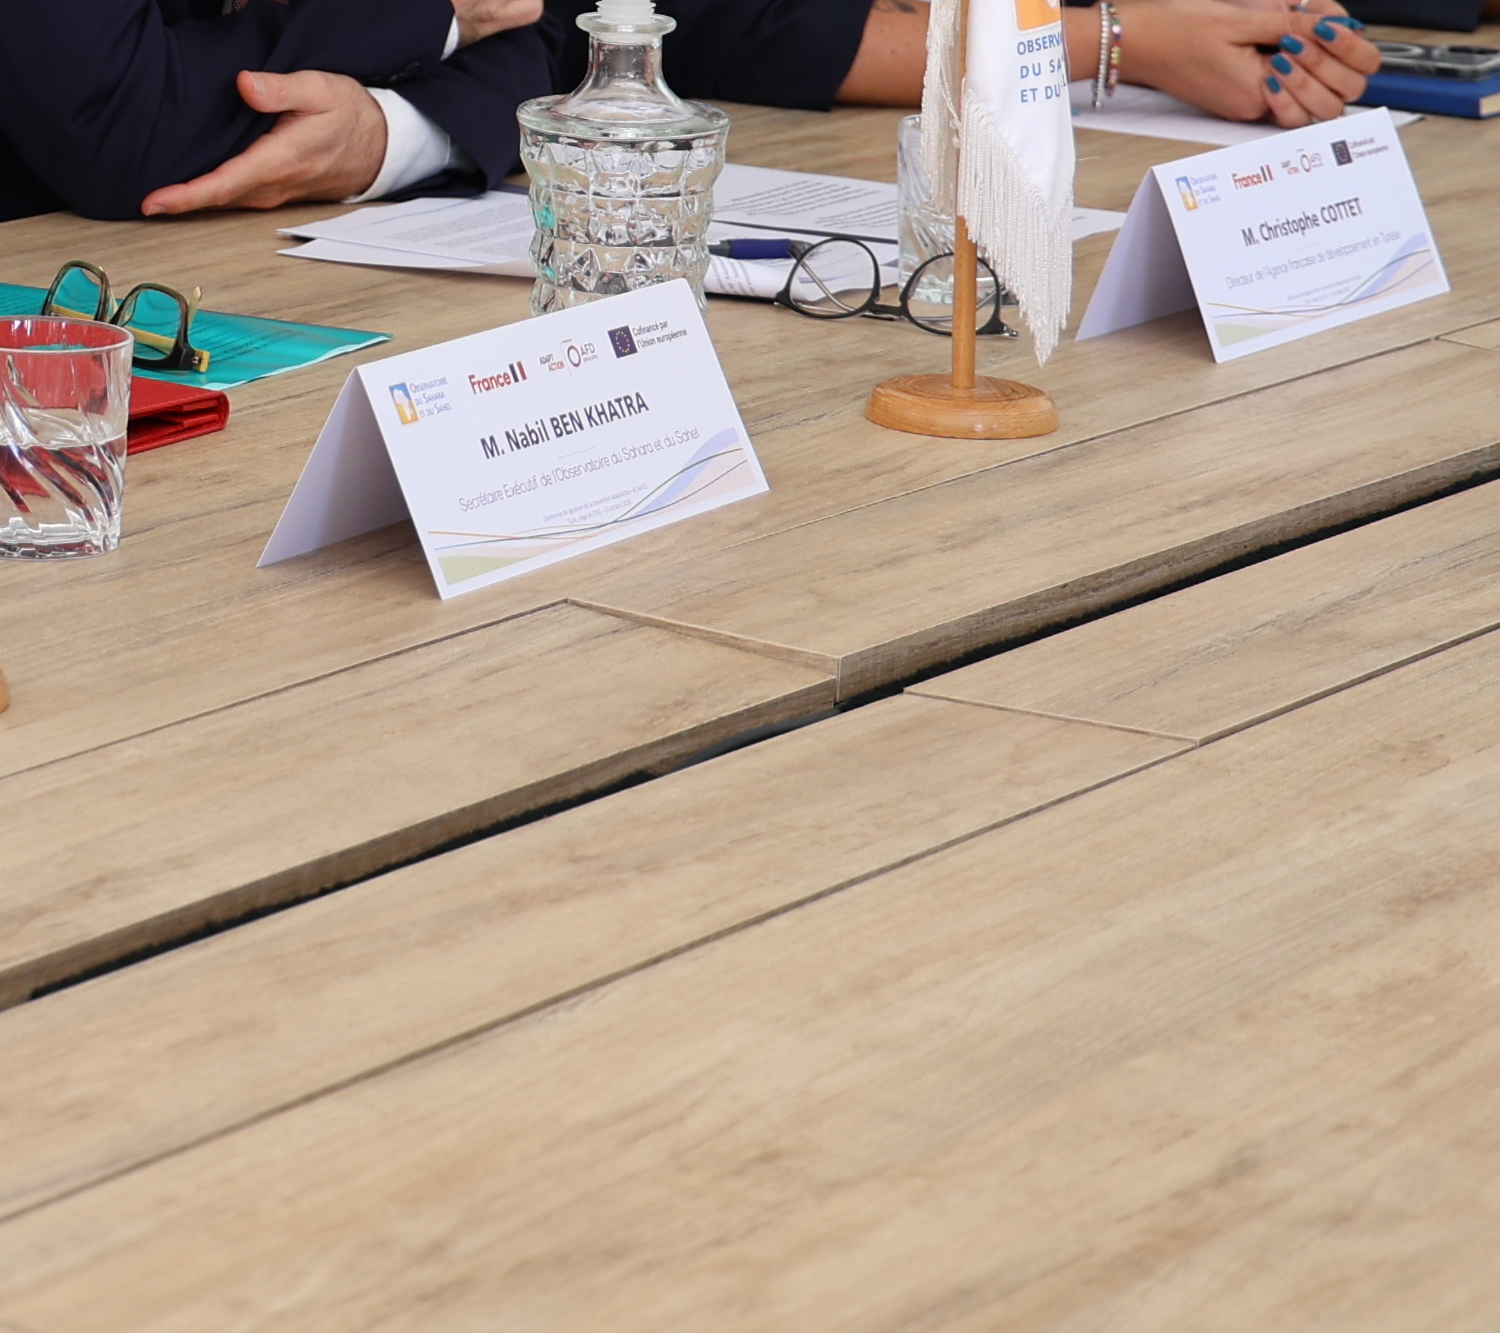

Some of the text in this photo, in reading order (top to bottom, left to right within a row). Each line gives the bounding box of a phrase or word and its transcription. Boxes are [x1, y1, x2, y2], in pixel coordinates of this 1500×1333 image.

[1020, 62, 1041, 79] DU
[1020, 88, 1038, 103] ET
[1232, 170, 1262, 189] France
[1242, 197, 1362, 246] M. Christophe COTTET
[468, 370, 512, 394] France
[480, 392, 649, 459] M. Nabil BEN KHATRA
[459, 427, 700, 513] Secrétaire Exécutif de l'Observatoire du Sahara et du Sahel
